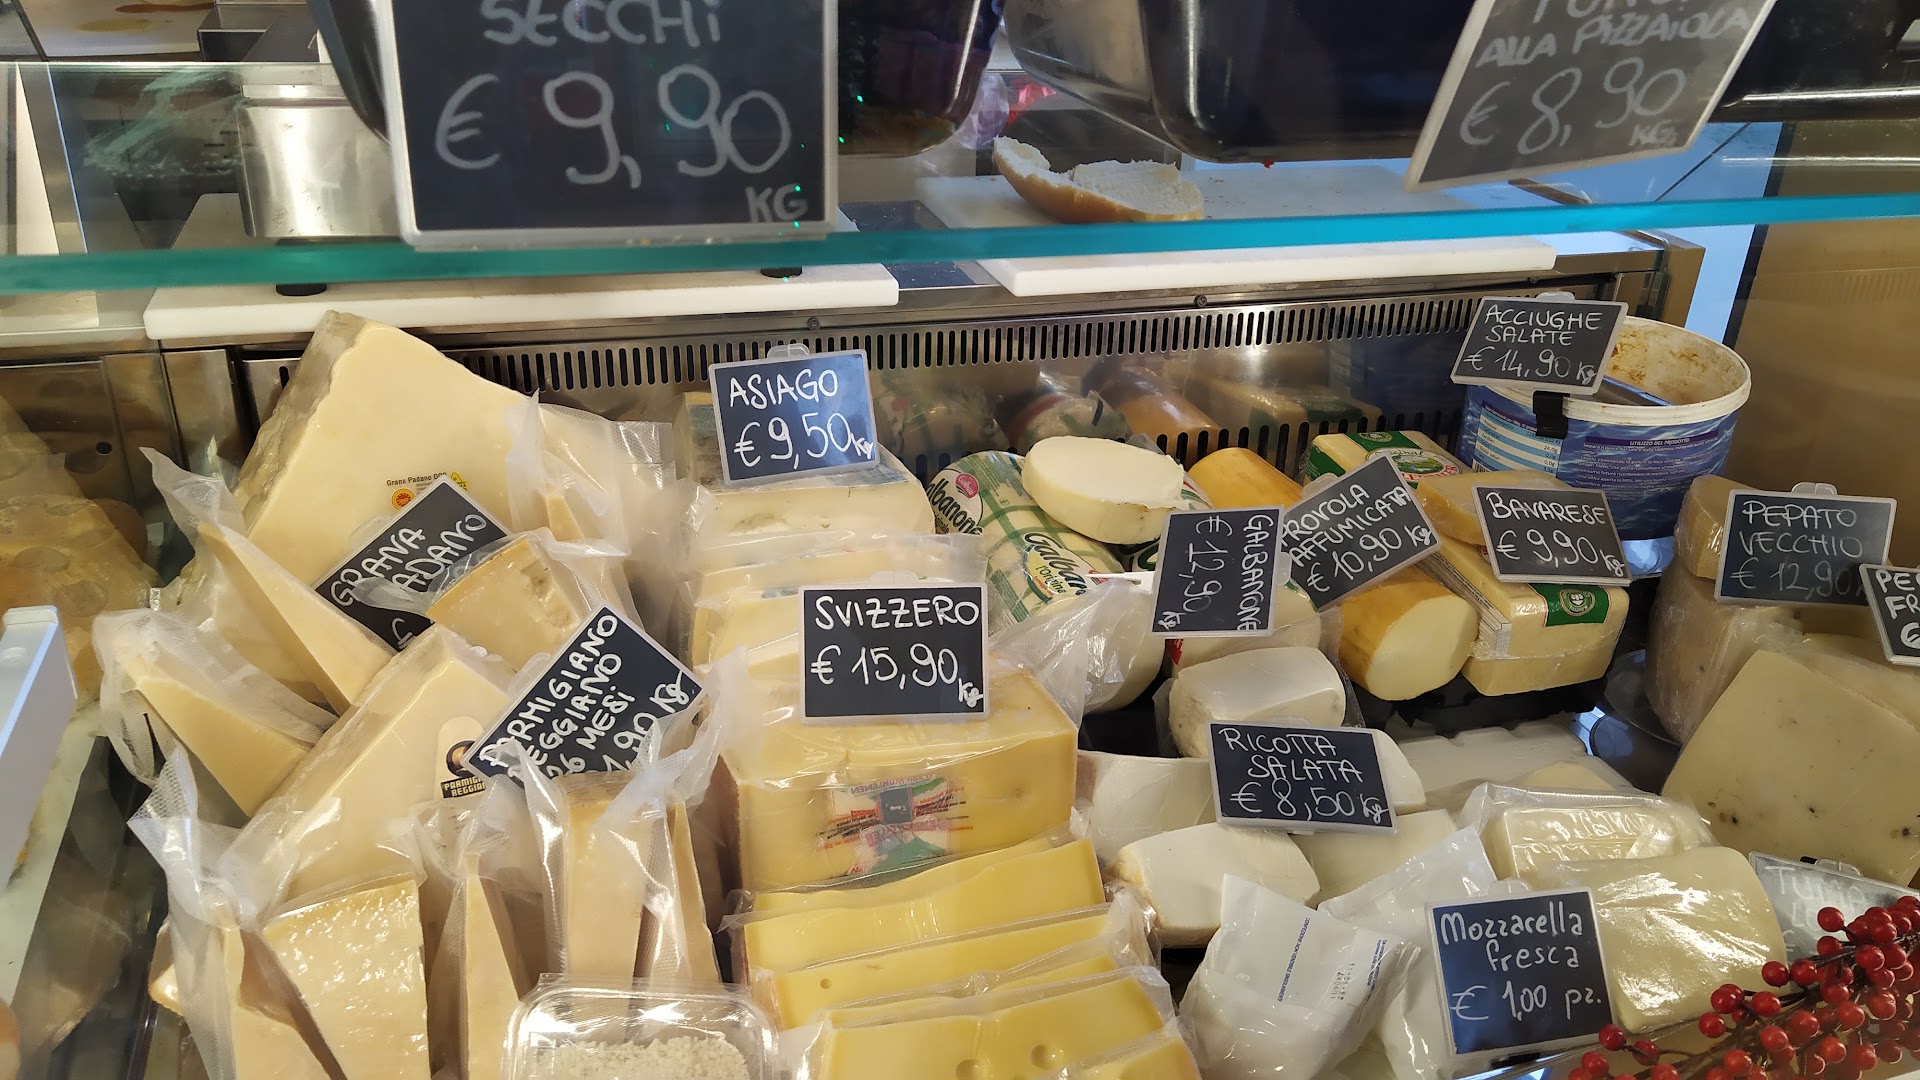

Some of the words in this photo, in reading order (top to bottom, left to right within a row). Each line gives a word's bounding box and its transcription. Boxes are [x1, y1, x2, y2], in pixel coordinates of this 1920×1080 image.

[1476, 34, 1557, 68] ALLA
[1460, 81, 1511, 145] €
[1517, 58, 1687, 155] 8,90
[435, 74, 499, 169] €
[543, 65, 791, 188] 9,90
[745, 184, 808, 224] KG
[1484, 304, 1604, 330] ACCIUGHE
[1485, 325, 1575, 346] SALATE
[1463, 346, 1495, 371] €
[1495, 349, 1571, 378] 14,90
[730, 368, 839, 410] ASIAGO
[386, 478, 407, 487] Grana
[407, 475, 433, 484] Padano
[1195, 514, 1233, 537] €
[1289, 485, 1412, 568] AFFUMICATA
[1486, 492, 1606, 525] BAVARESE
[1741, 500, 1857, 530] PEPATO
[1307, 562, 1331, 593] €
[1333, 527, 1402, 581] 10,90
[1497, 530, 1521, 560] €
[1526, 528, 1599, 569] 9,90
[1739, 531, 1863, 559] VECCHIO
[330, 528, 426, 606] GRANA
[1237, 514, 1275, 631] GALBANONE
[1730, 556, 1760, 590] €
[1769, 560, 1851, 600] 12,90
[815, 595, 980, 631] SVIZZERO
[810, 644, 842, 686] €
[851, 642, 959, 691] 15,90
[1218, 728, 1337, 757] RICOTTA
[1247, 754, 1364, 783] SALATA
[1230, 782, 1262, 813] €
[1271, 777, 1356, 821] 8,50
[1440, 900, 1583, 945] Mozzarella
[1486, 938, 1580, 972] fresca
[1450, 985, 1490, 1021] €
